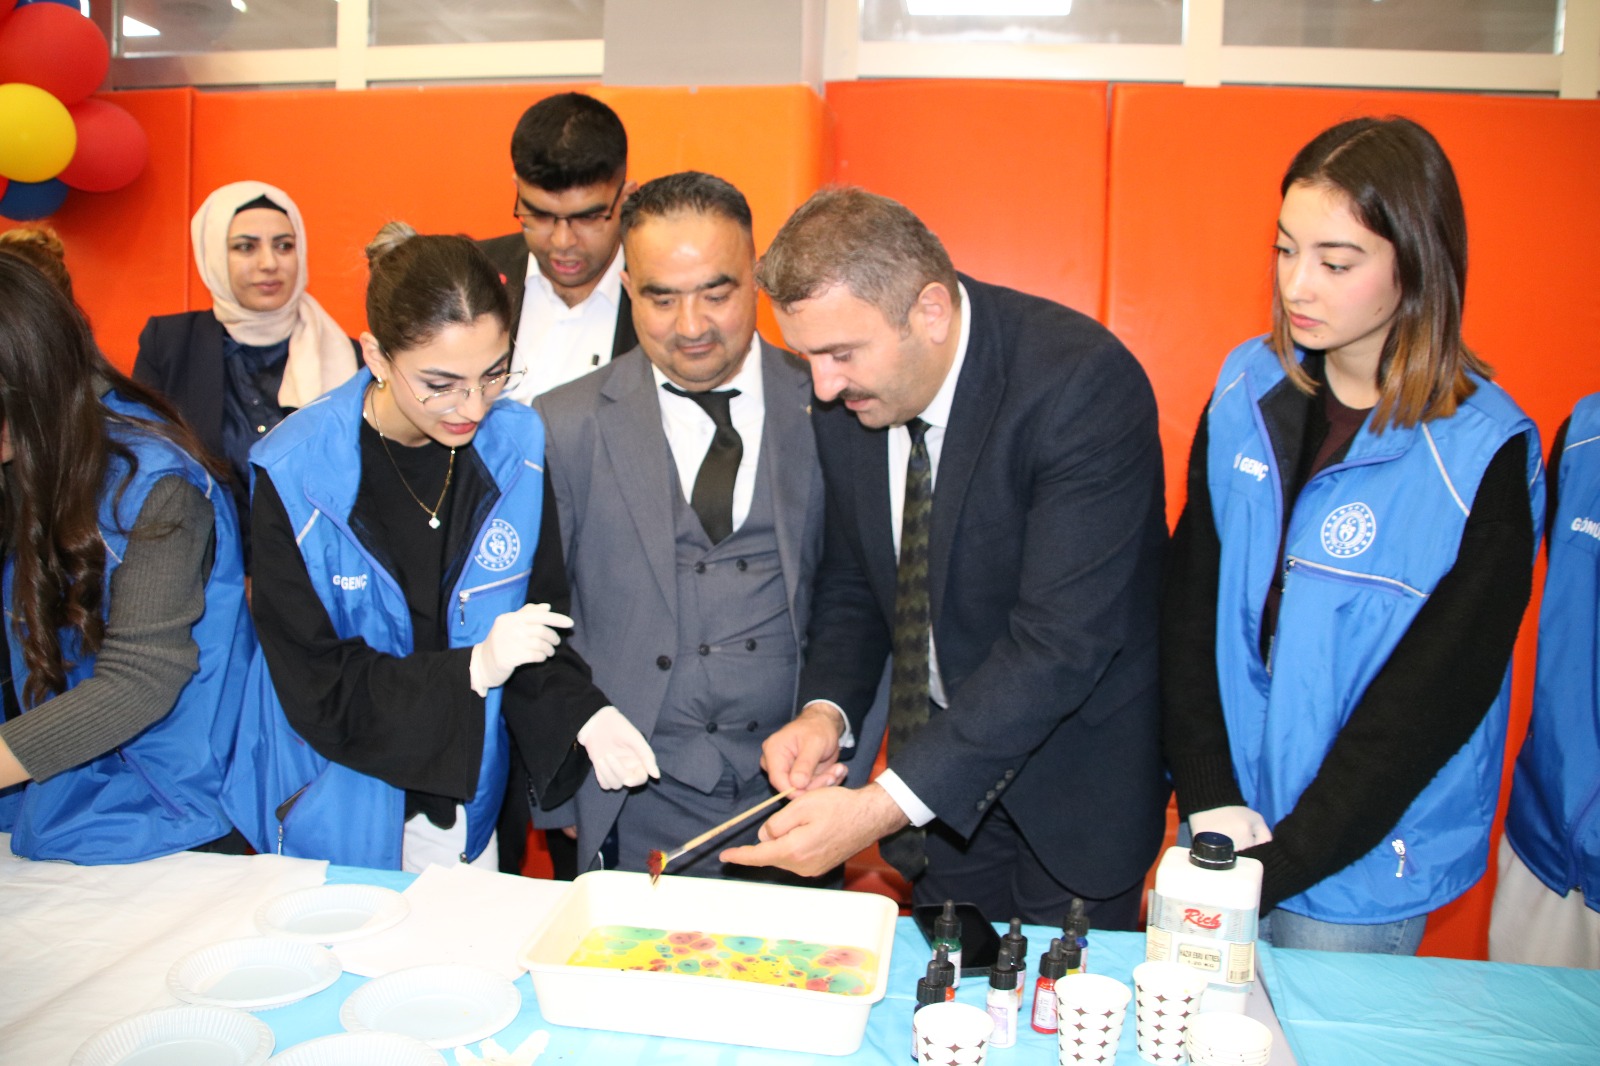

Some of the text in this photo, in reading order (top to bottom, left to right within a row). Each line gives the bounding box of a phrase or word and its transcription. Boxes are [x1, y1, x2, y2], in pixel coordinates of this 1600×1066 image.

[1239, 457, 1269, 481] GENÇ
[341, 573, 367, 590] GENÇ
[1184, 908, 1221, 929] Rich
